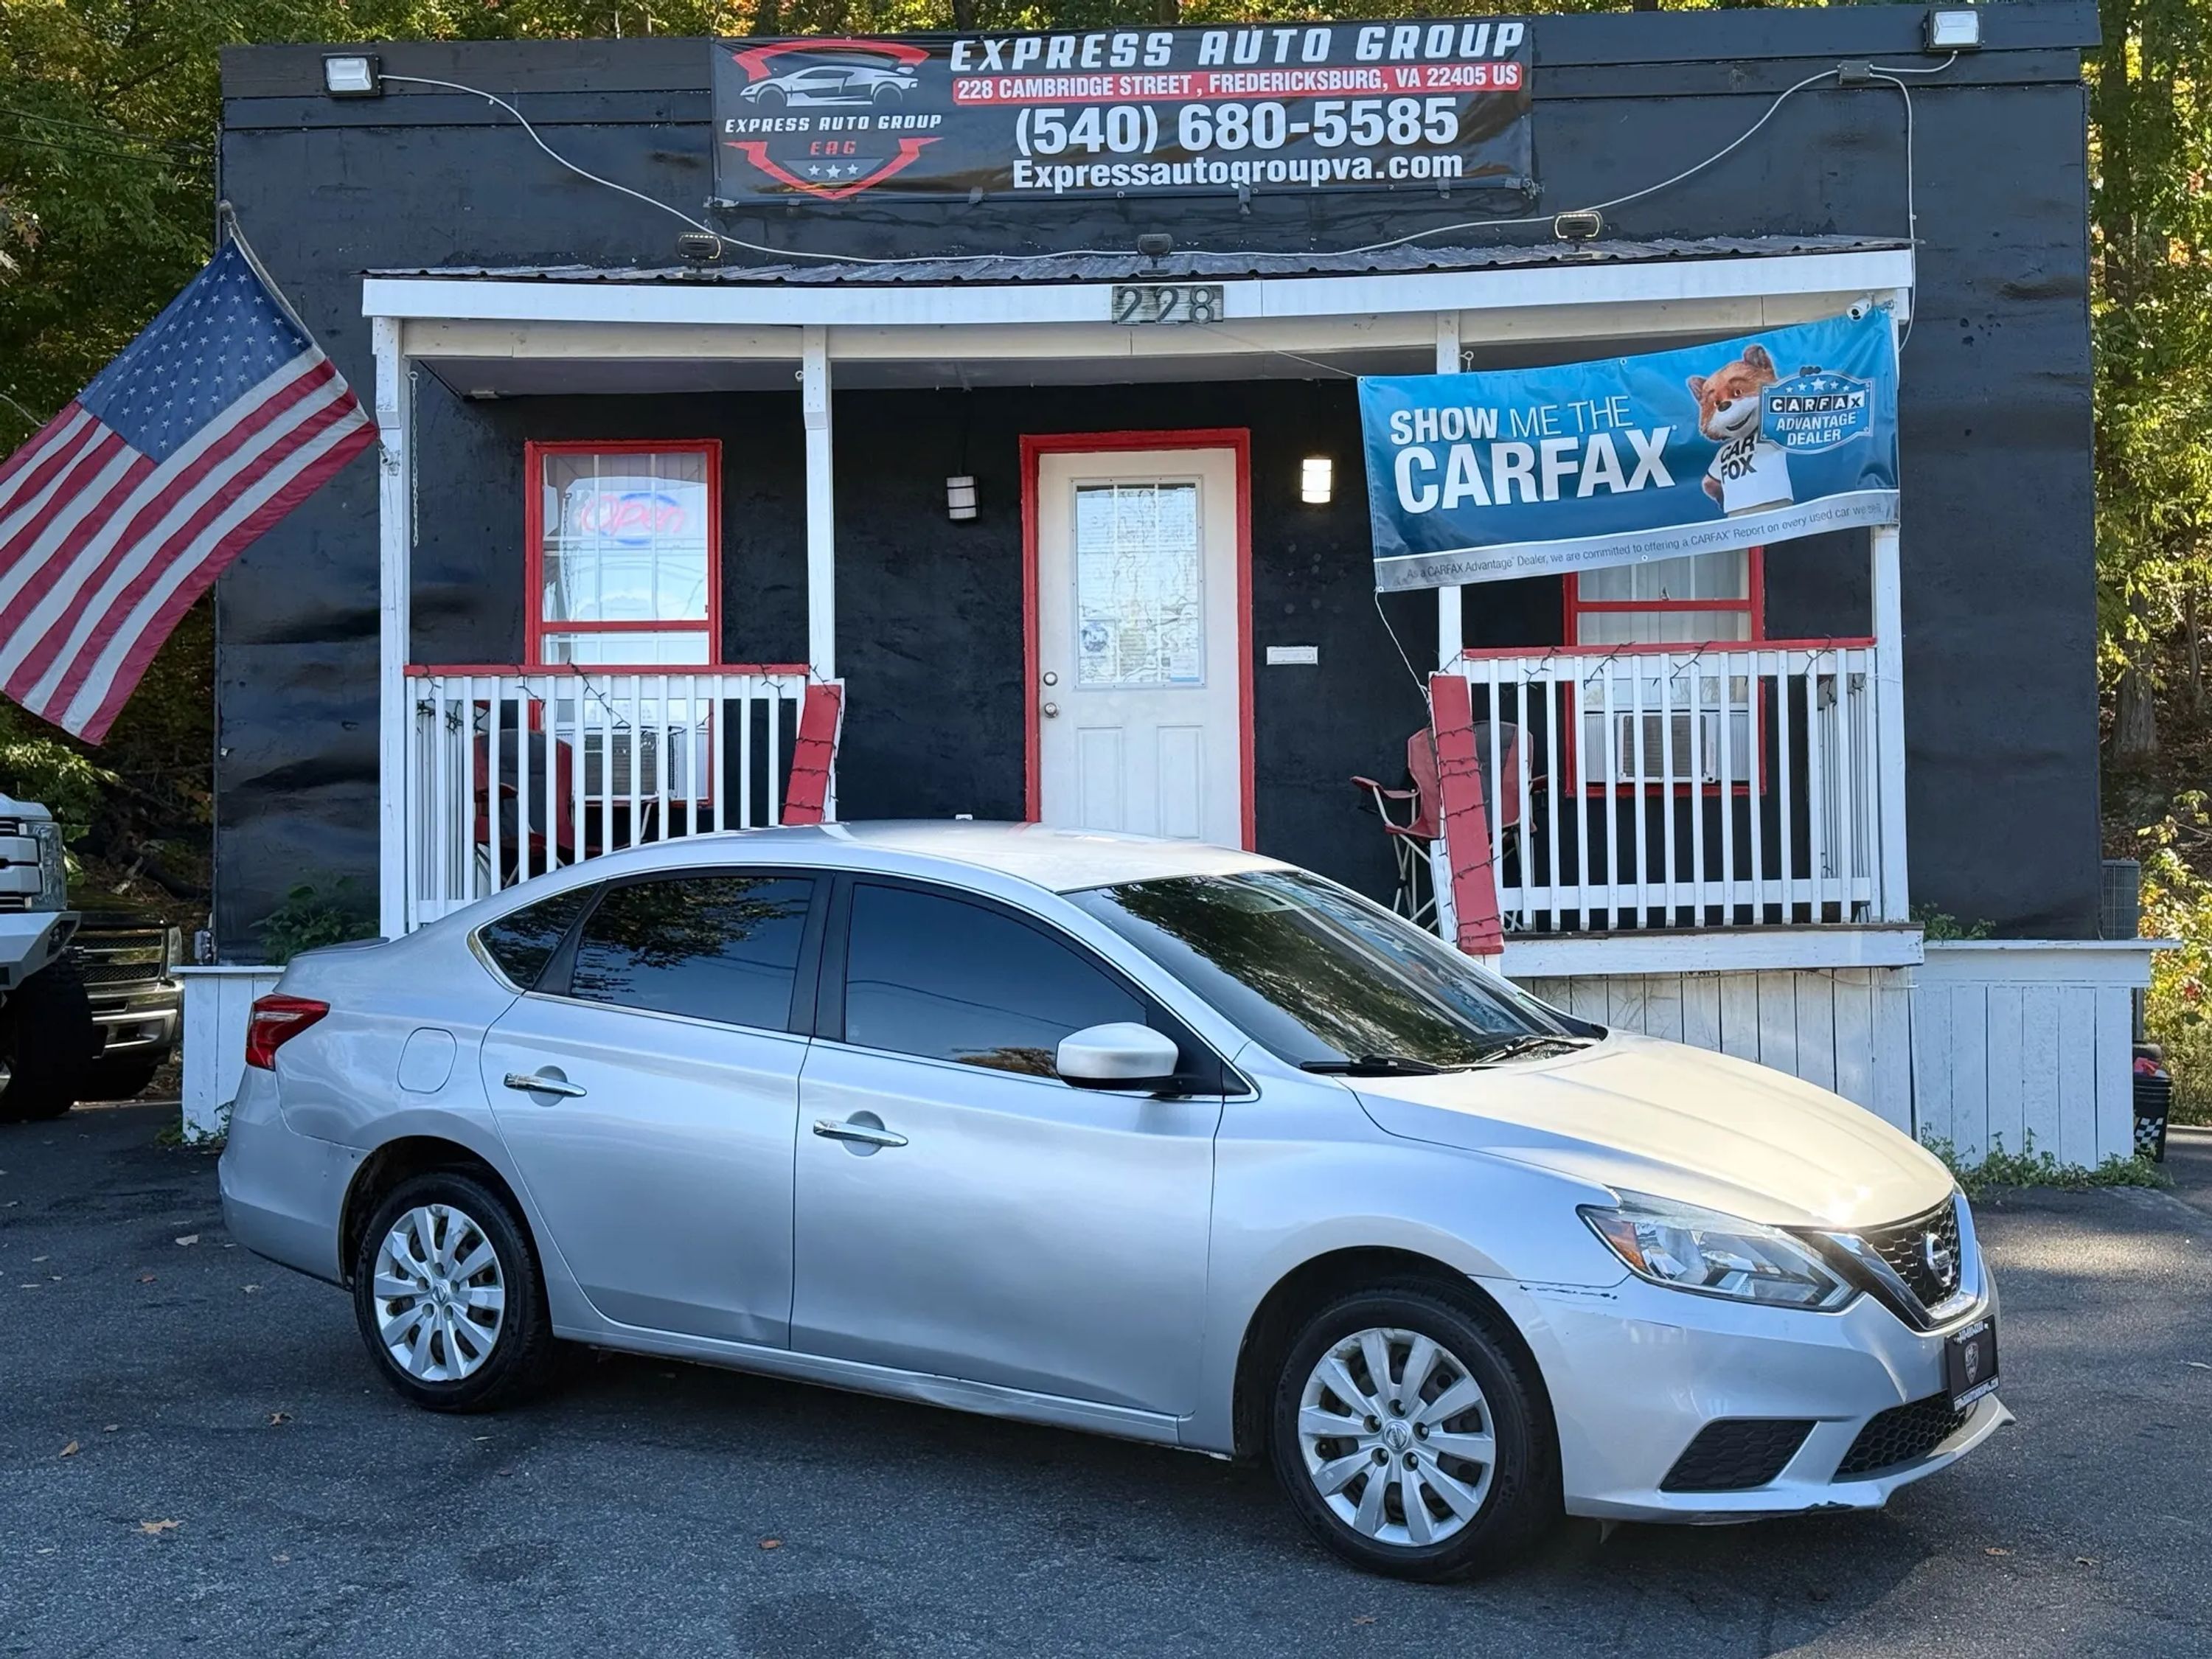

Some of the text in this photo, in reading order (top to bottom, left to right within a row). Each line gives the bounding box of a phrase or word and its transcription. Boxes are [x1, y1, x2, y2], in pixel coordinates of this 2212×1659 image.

[950, 22, 1525, 72] EXPRESS AUTO GROUP
[958, 80, 992, 100] 228
[999, 76, 1113, 99] CAMBRIDGE
[1119, 74, 1192, 95] STREET
[1209, 68, 1388, 94] FREDERICKSBURG,
[1396, 68, 1420, 88] VA
[1427, 66, 1486, 86] 22405
[1492, 64, 1517, 85] US
[725, 115, 942, 133] EXPRESS AUTO GROUP
[1016, 97, 1458, 156] (540) 680-5585
[810, 141, 857, 156] EAG
[1013, 154, 1462, 193] Expressautogroupva.com
[1117, 285, 1214, 325] 228
[1389, 396, 1634, 445] SHOW ME THE
[1771, 395, 1862, 412] CARFAX
[1775, 411, 1857, 431] ADVANTAGE
[1720, 435, 1755, 464] CAR
[1787, 429, 1842, 446] DEALER
[1394, 425, 1676, 514] CARFAX
[1720, 453, 1758, 484] FOX
[1427, 562, 1464, 577] CARFAX
[1517, 554, 1548, 566] Dealer,
[1550, 554, 1563, 563] we
[1565, 552, 1580, 562] are
[1582, 543, 1631, 560] committed
[1632, 543, 1642, 554] to
[1644, 539, 1680, 552] offering
[1733, 524, 1765, 539] Report
[1767, 524, 1779, 532] on
[1809, 511, 1833, 523] used
[1834, 507, 1851, 517] car
[1852, 505, 1866, 515] we
